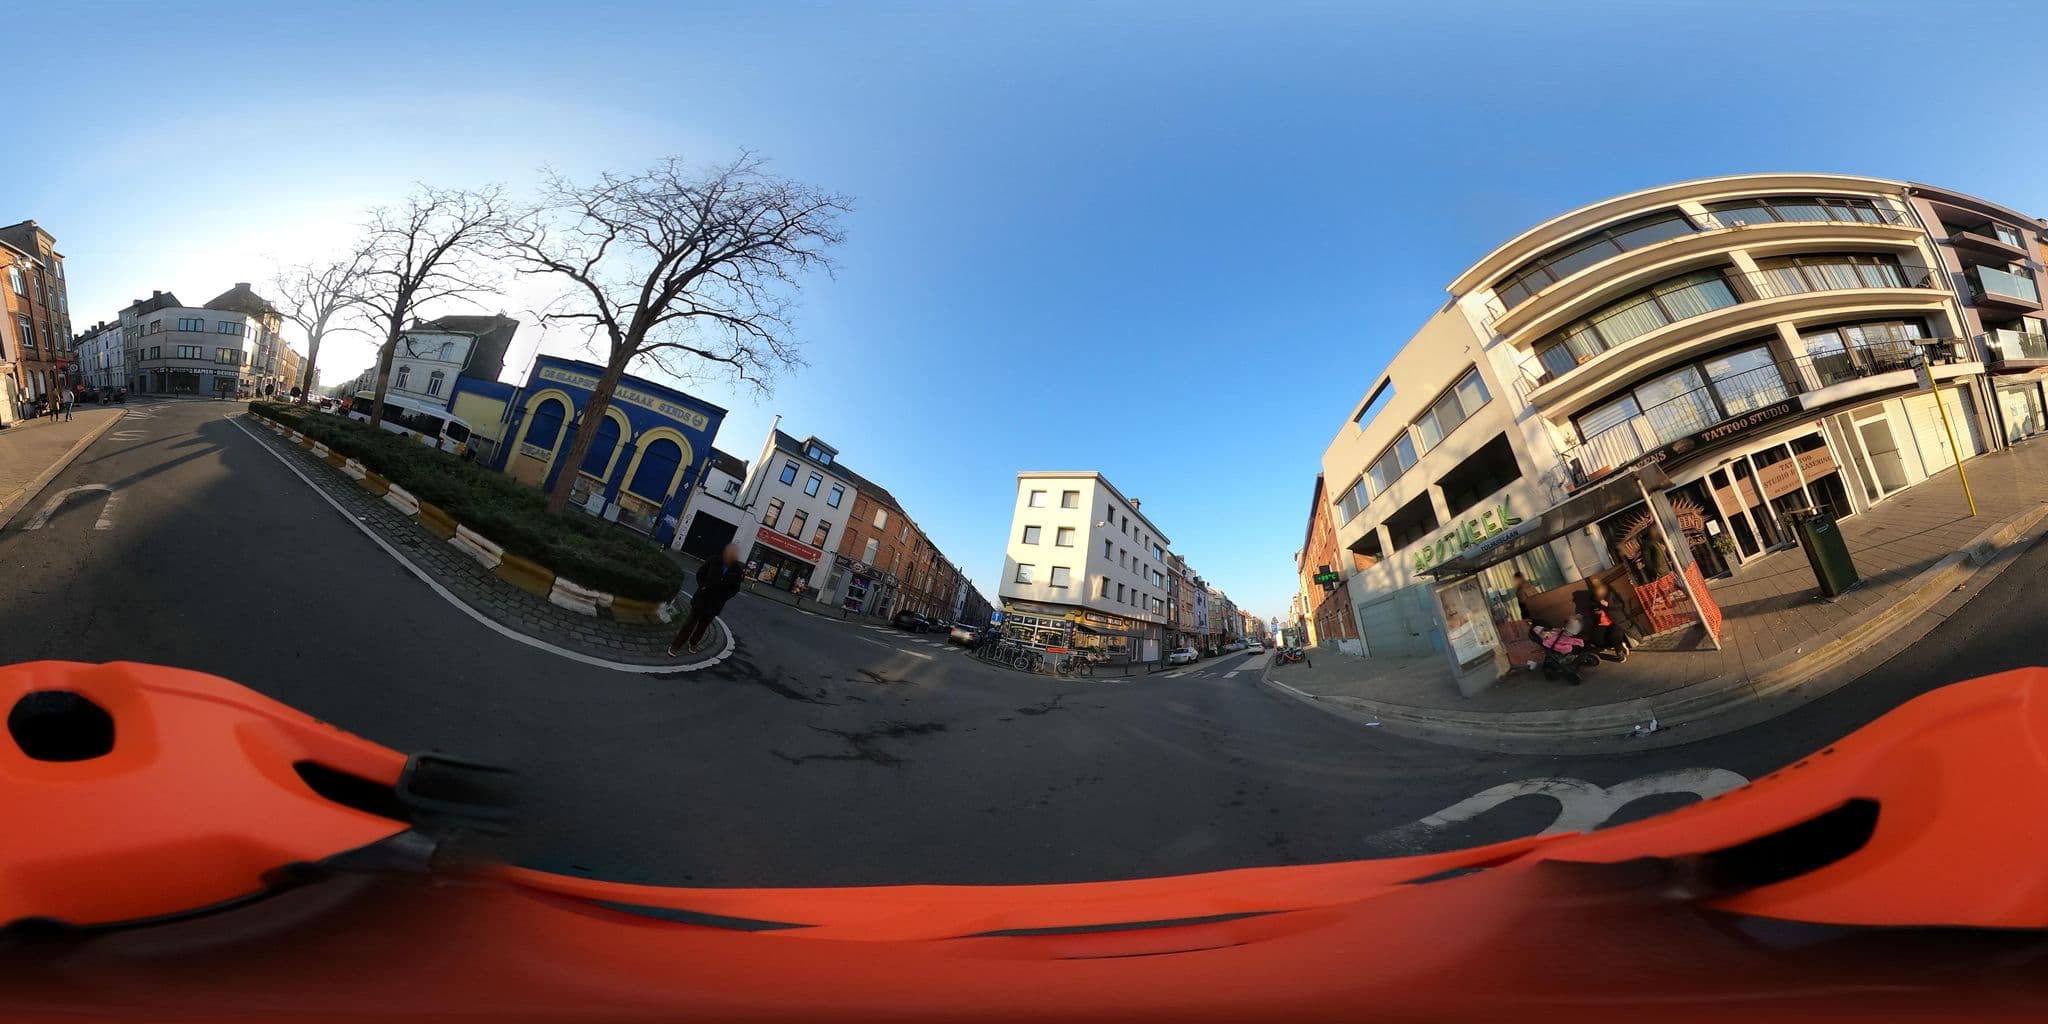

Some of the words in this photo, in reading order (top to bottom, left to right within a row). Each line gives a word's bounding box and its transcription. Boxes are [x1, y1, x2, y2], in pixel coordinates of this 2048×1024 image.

[1701, 421, 1748, 442] TATTOO
[1750, 404, 1789, 425] STUDIO
[1763, 472, 1788, 489] STUDIO
